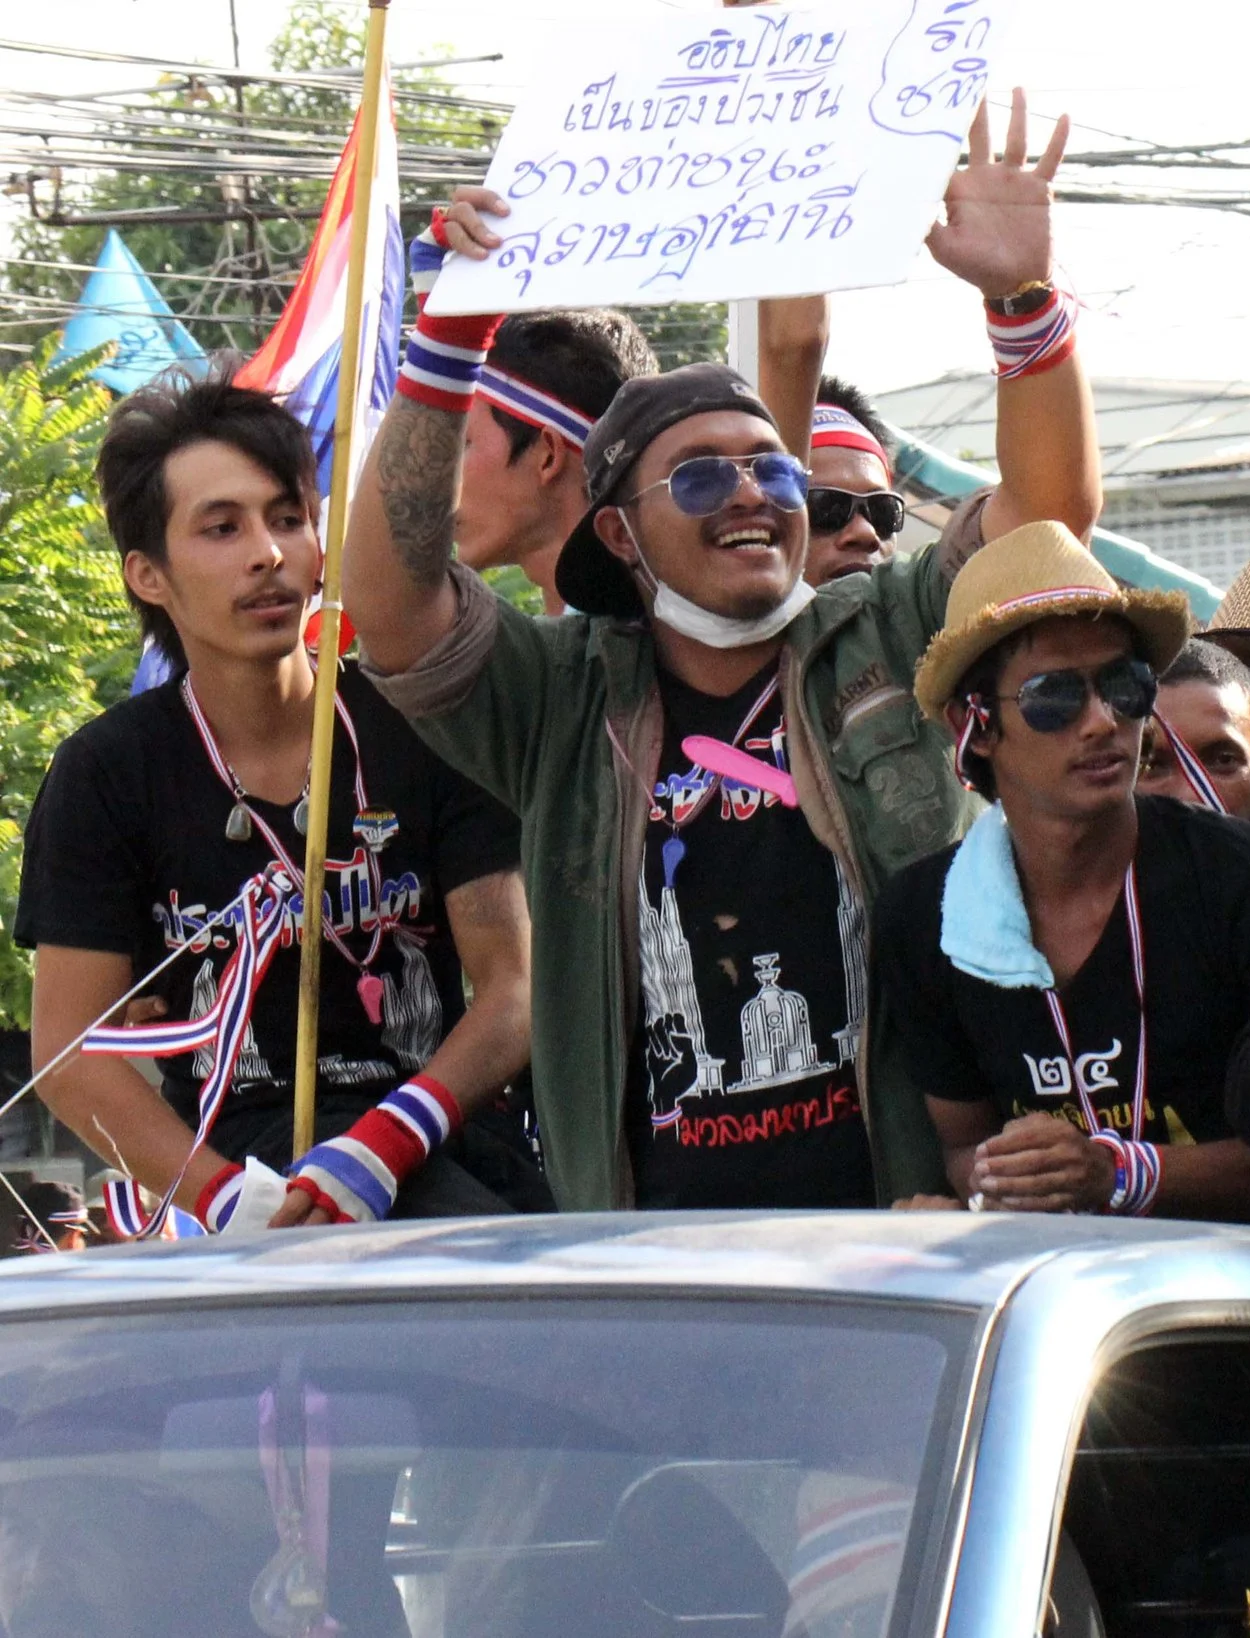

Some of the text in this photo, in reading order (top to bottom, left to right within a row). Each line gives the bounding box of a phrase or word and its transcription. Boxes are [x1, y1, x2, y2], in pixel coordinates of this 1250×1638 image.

[677, 14, 847, 69] อธิปไตย
[924, 0, 992, 52] รัก
[563, 73, 845, 131] เป็นของปวงชน
[506, 139, 838, 201] ชาวท่าชนะ
[496, 170, 865, 297] สุราษฎร์ธานี
[1022, 1037, 1123, 1096] ๒๔
